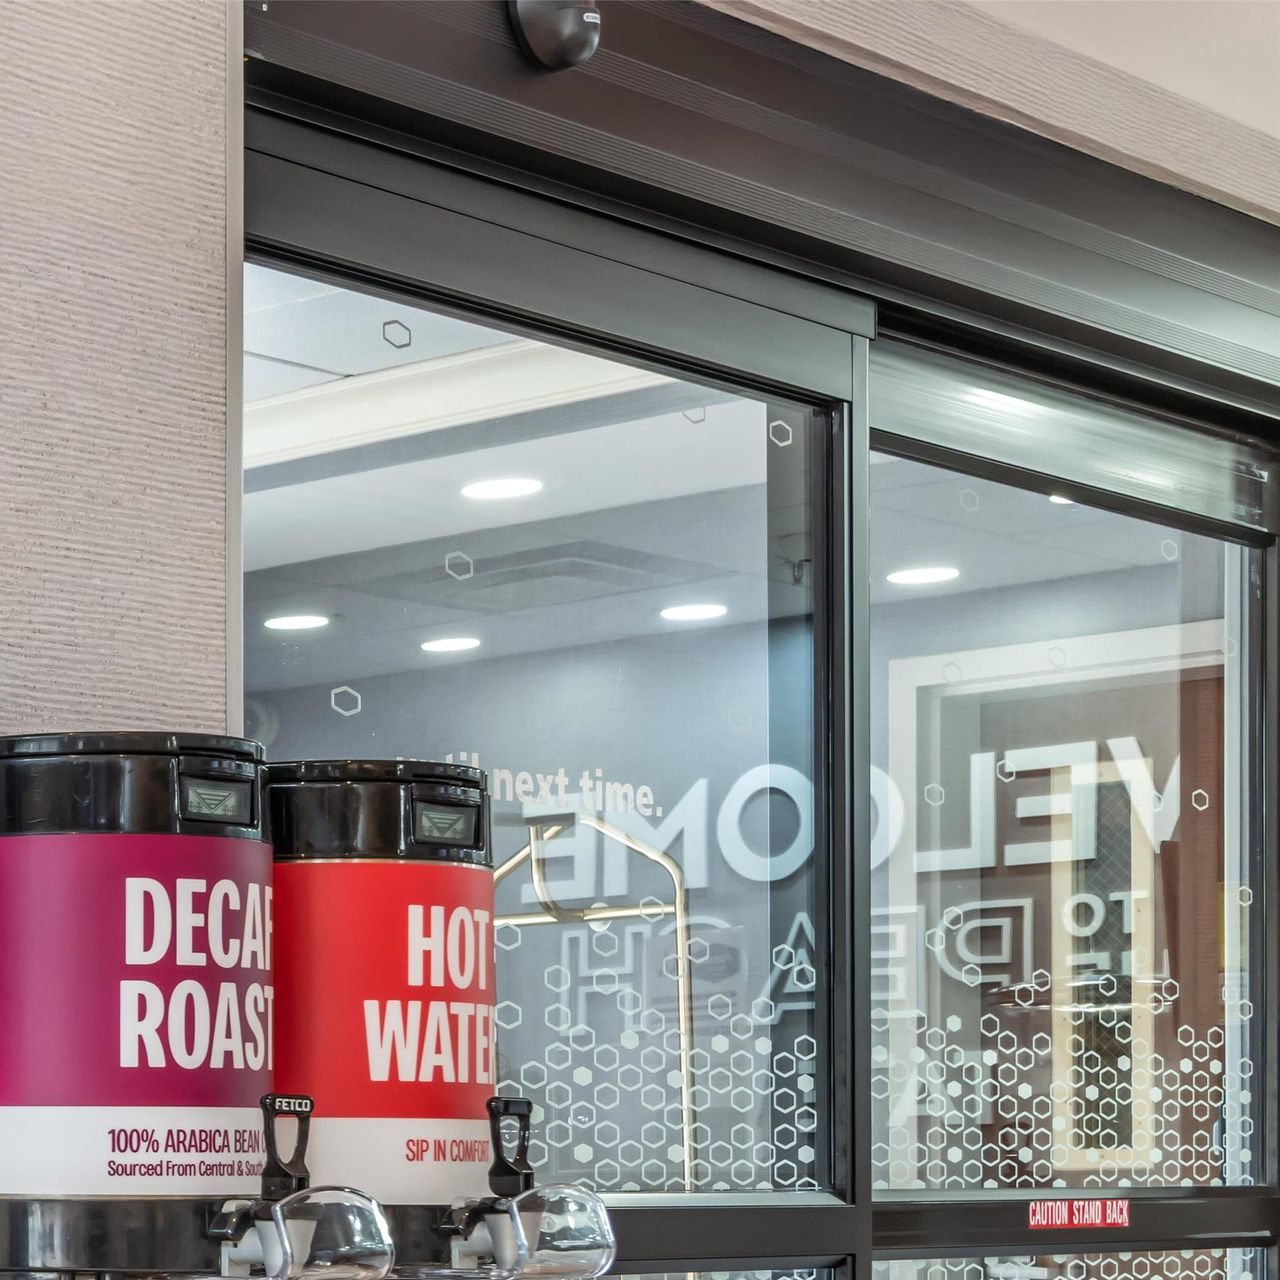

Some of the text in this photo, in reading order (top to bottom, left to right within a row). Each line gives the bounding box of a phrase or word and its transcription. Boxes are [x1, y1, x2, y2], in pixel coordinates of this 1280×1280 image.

[493, 768, 663, 817] next time.
[407, 905, 489, 991] HOT
[119, 979, 273, 1071] ROAST
[275, 1098, 310, 1111] FETCO
[107, 1129, 160, 1153] 100%
[164, 1129, 230, 1153] ARABICA
[234, 1129, 260, 1153] BEAN
[405, 1139, 489, 1162] SIP IN COMFORT
[107, 1160, 163, 1177] Sourced
[166, 1160, 196, 1177] From
[198, 1160, 235, 1177] Central
[237, 1160, 244, 1176] &
[1029, 1200, 1129, 1225] CAUTION STAND BACK
